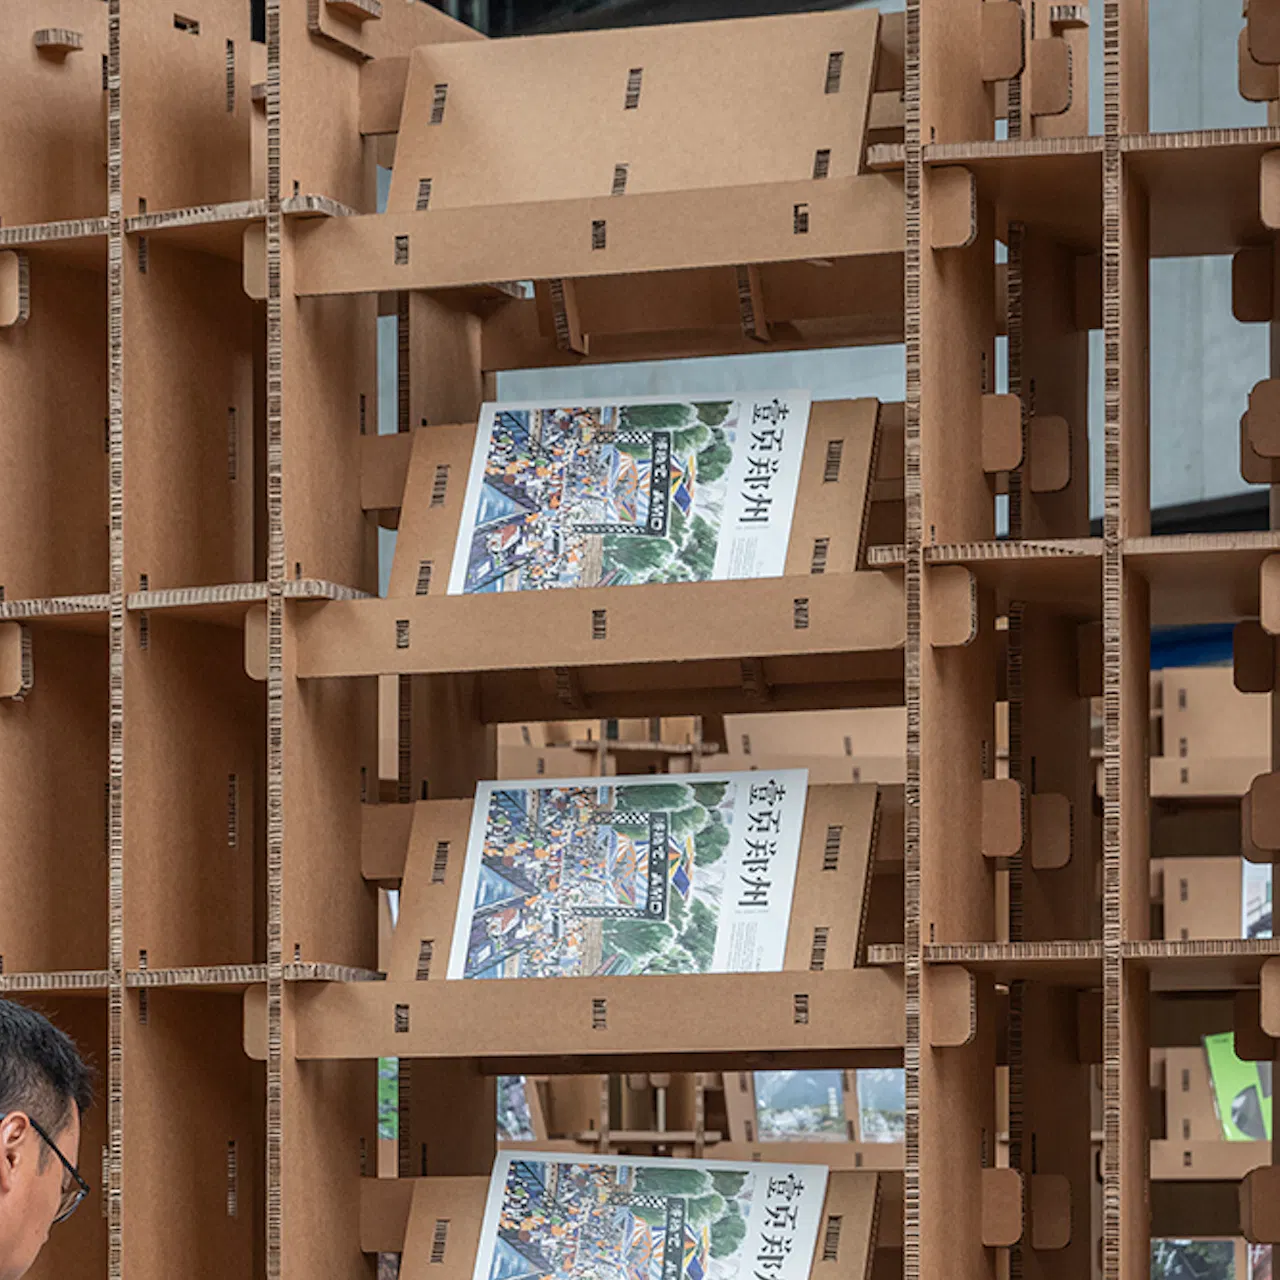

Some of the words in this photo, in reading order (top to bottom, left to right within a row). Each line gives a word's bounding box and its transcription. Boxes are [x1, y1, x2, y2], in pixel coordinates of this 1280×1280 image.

[738, 398, 790, 523] 壹页郑州
[738, 777, 787, 907] 壹页郑州
